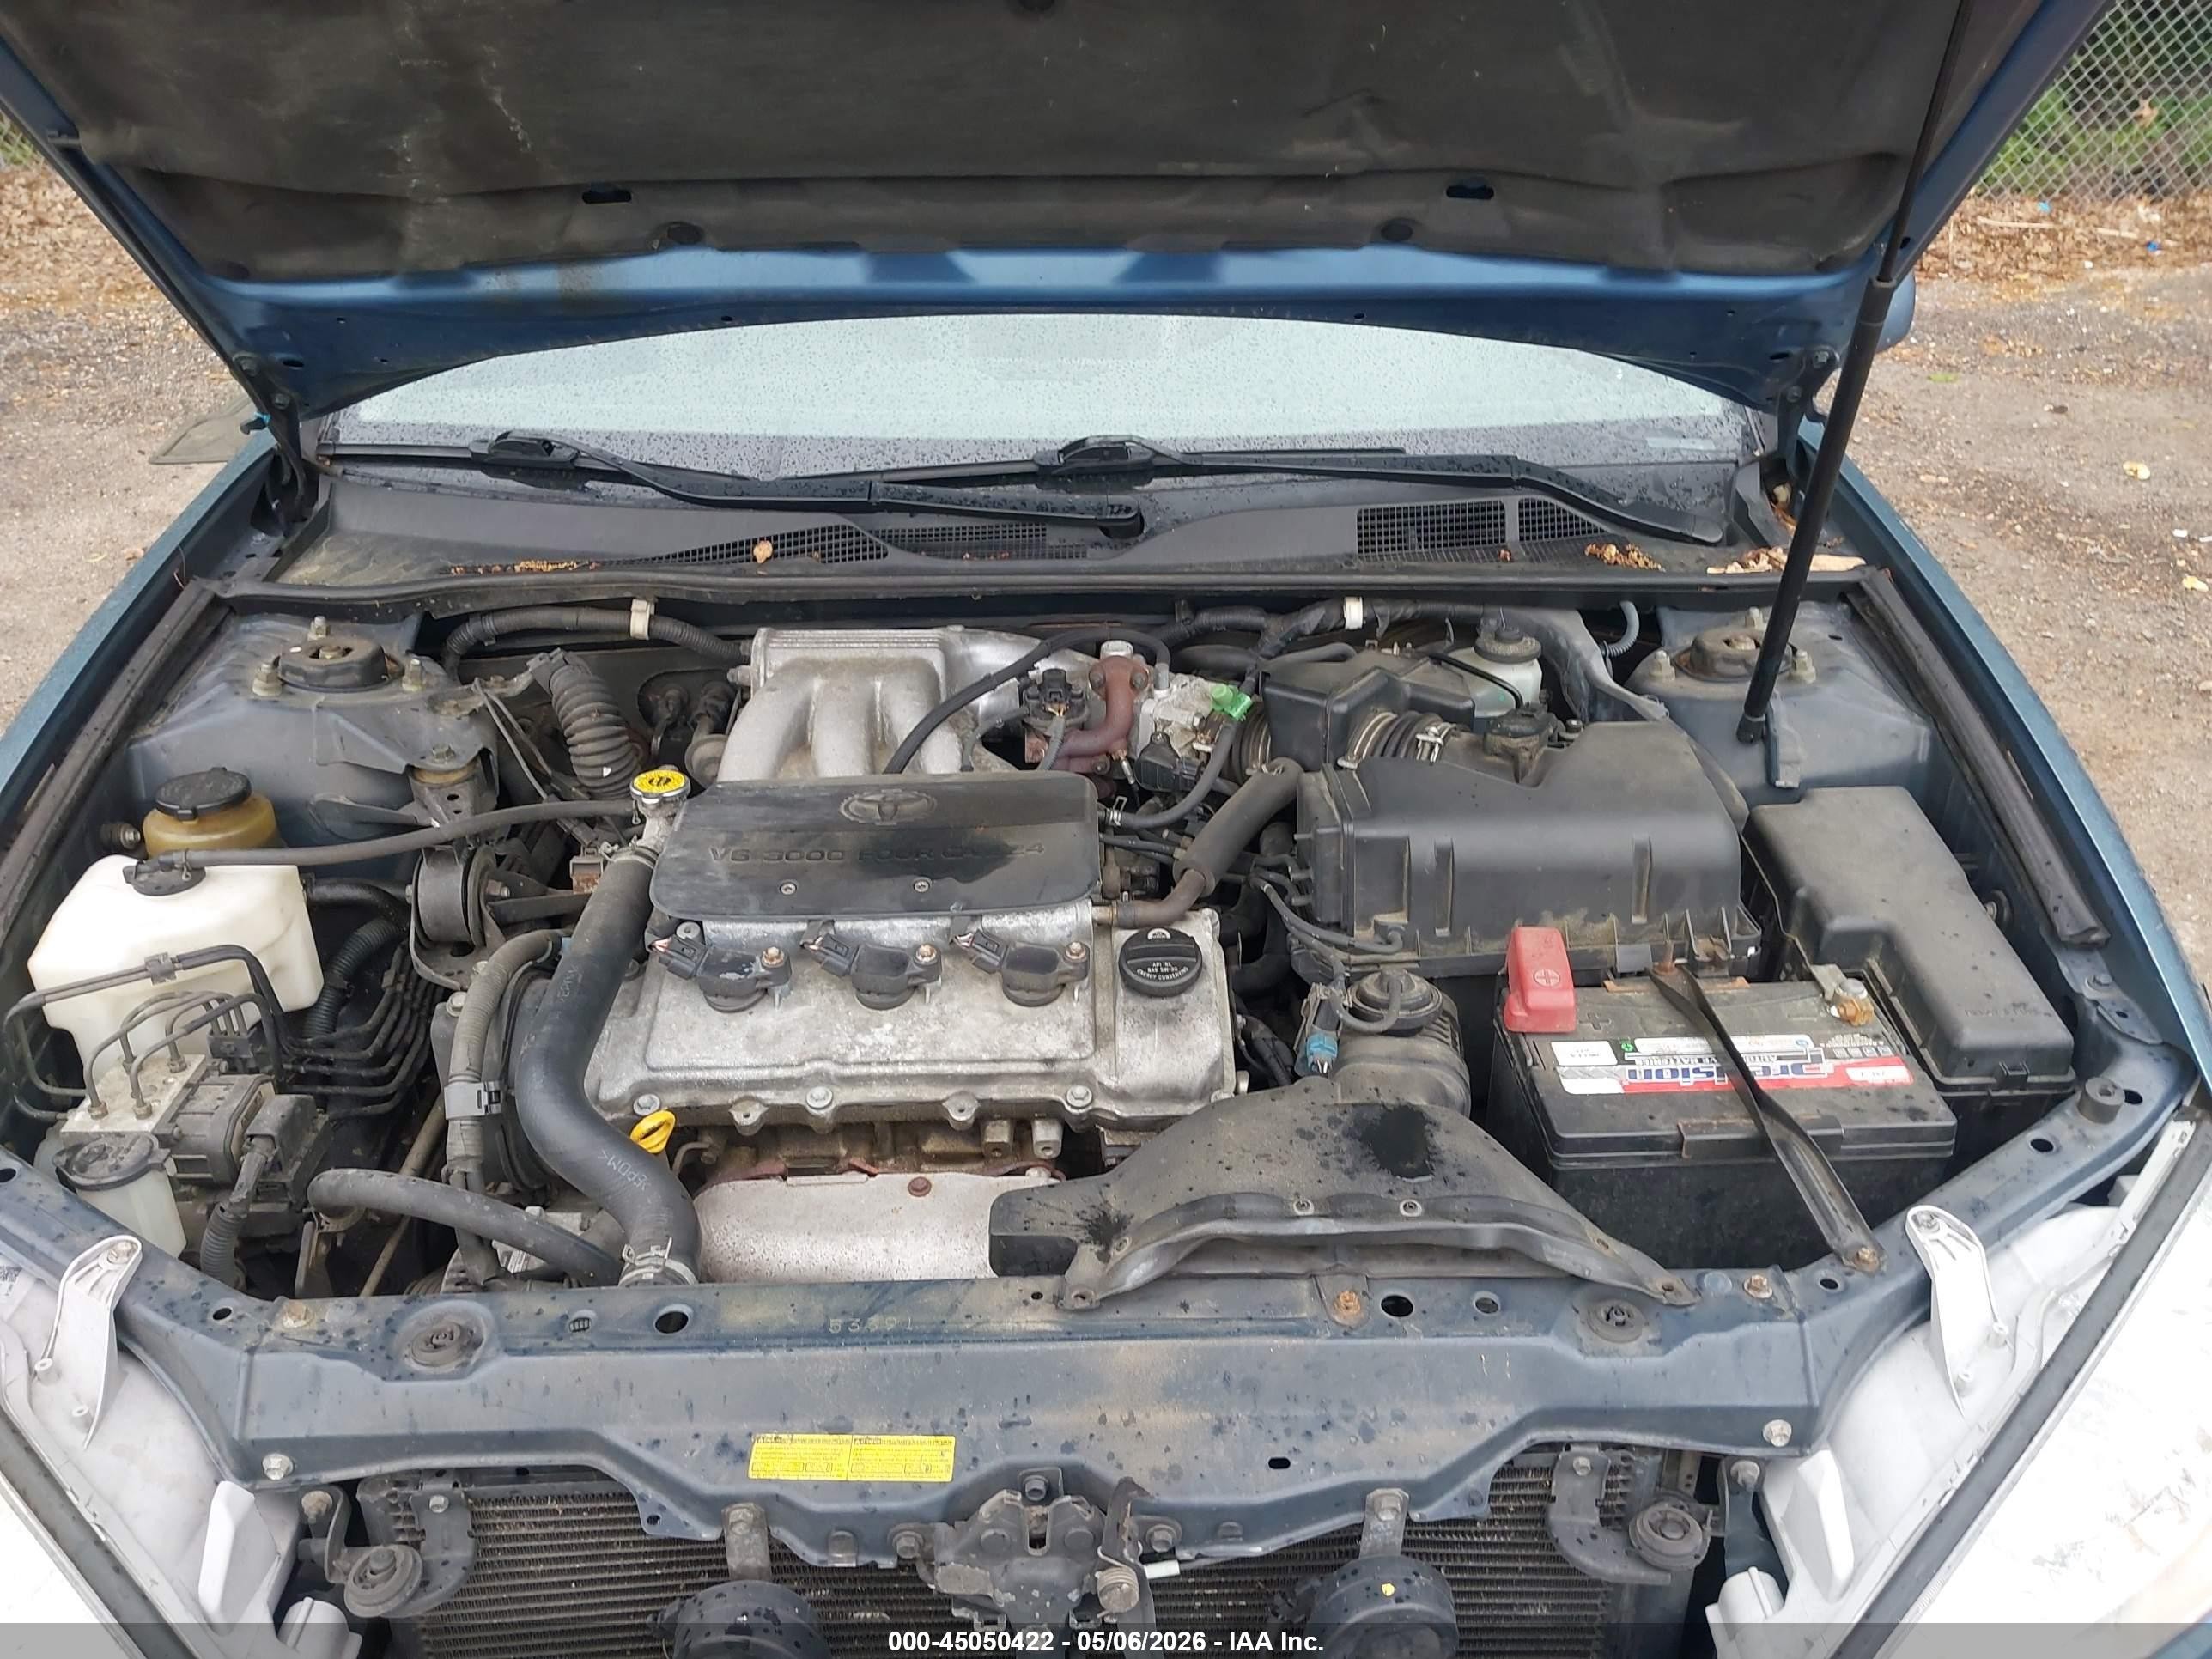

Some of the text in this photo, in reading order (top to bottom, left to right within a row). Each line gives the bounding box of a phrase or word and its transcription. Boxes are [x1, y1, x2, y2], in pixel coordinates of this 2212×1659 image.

[710, 846, 750, 862] V6
[763, 848, 846, 862] 3000
[859, 848, 936, 862] FOUR
